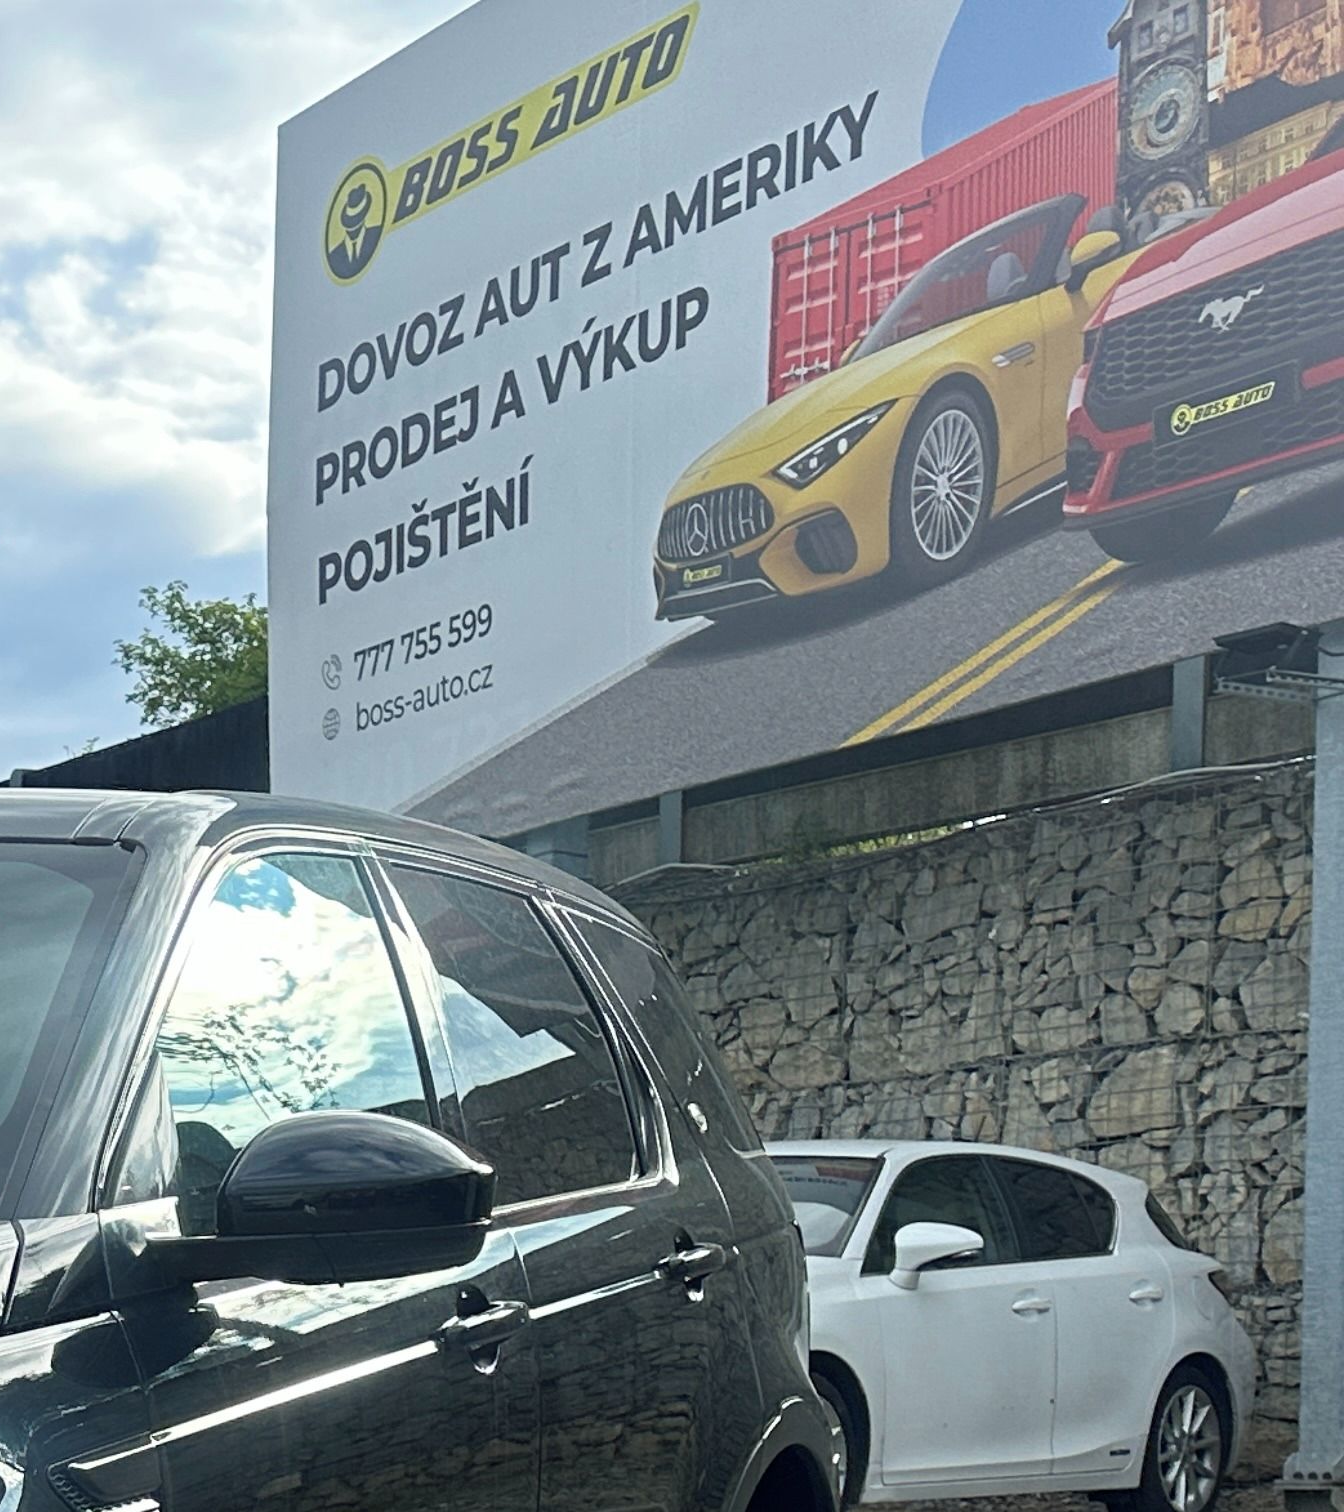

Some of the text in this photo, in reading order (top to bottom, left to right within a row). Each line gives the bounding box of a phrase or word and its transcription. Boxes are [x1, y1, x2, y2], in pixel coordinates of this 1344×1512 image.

[392, 14, 690, 224] BOSS AUTO
[318, 89, 880, 413] DOVOZ AUT Z AMERIKY
[315, 286, 710, 506] PRODEJ A VÝKUP
[318, 453, 535, 605] POJIŠTĚNÍ
[353, 603, 493, 682] 777 755 599
[356, 664, 494, 732] boss-auto.cz
